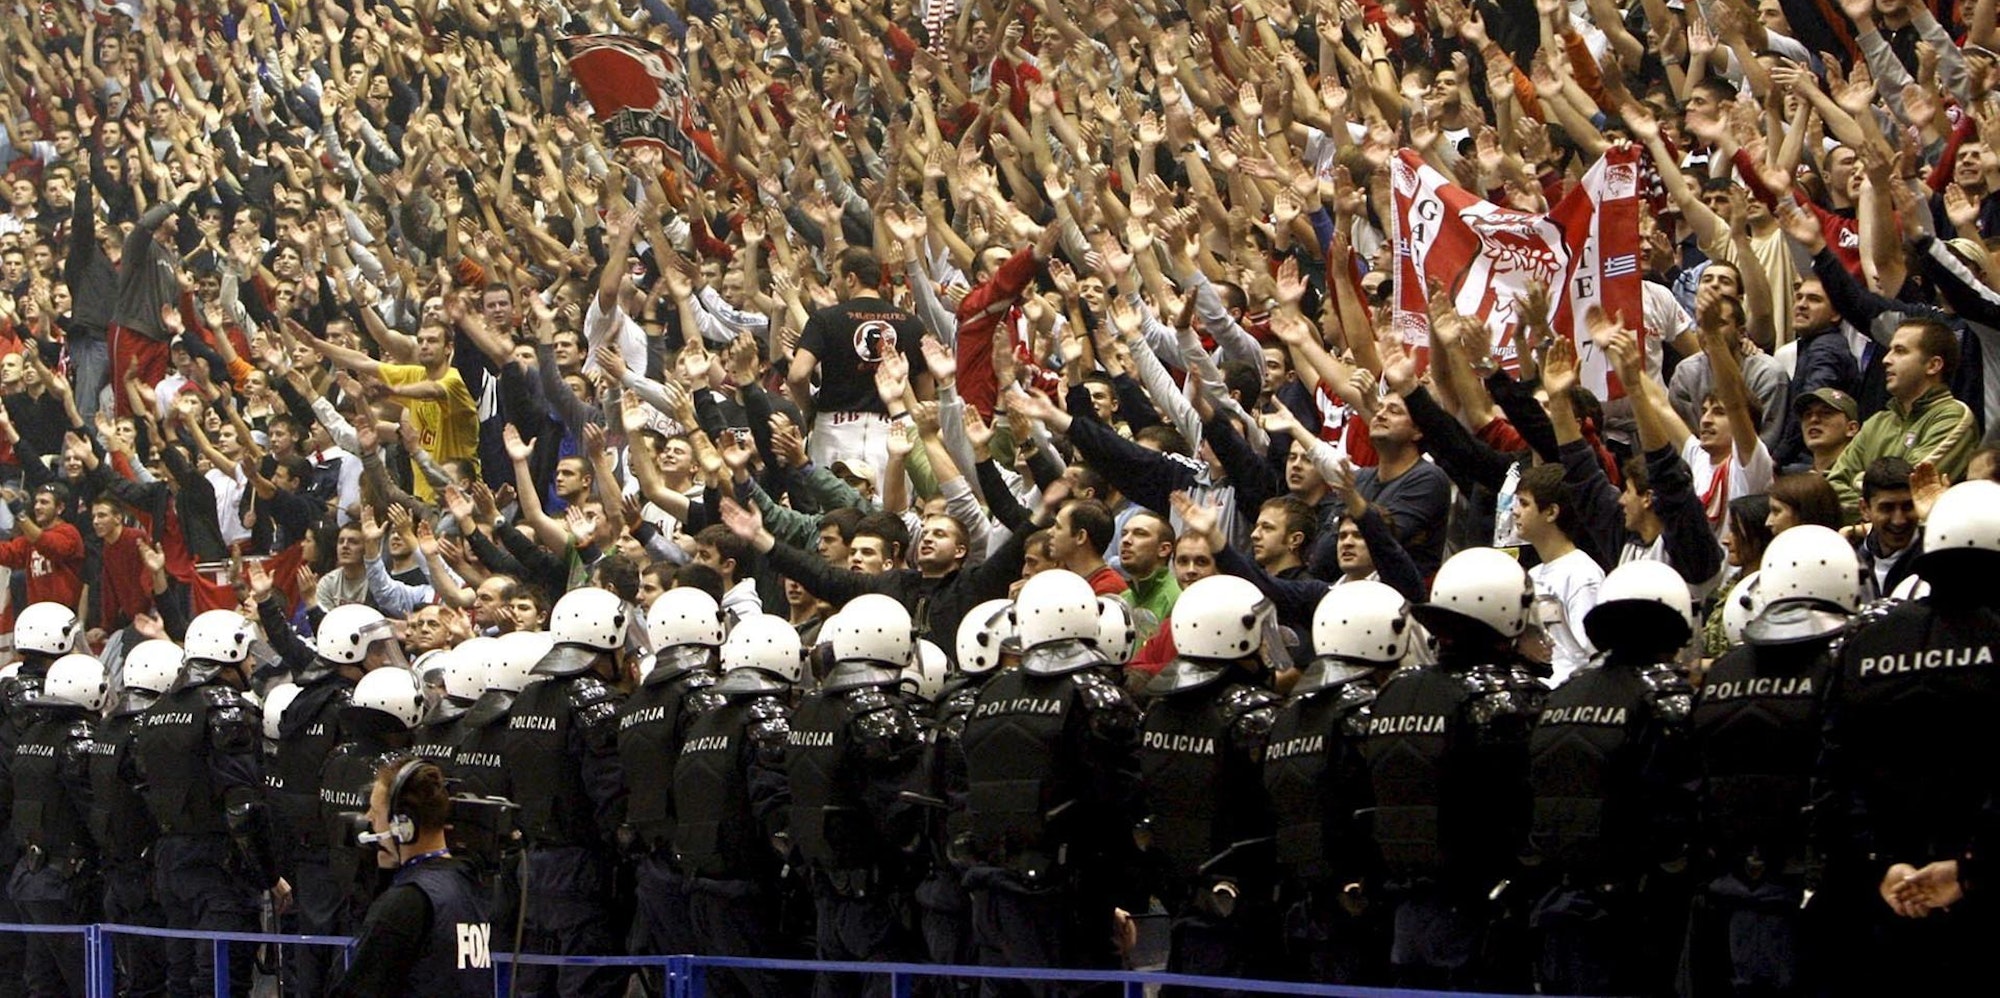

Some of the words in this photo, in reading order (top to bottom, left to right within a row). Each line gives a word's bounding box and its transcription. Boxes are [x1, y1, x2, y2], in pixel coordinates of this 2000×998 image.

[1582, 341, 1593, 362] 7
[1860, 645, 1993, 677] POLICIJA
[1704, 677, 1813, 700] POLICIJA
[148, 711, 193, 726] POLICIJA
[620, 705, 665, 728] POLICIJA
[974, 698, 1062, 718] POLICIJA
[1540, 706, 1628, 726] POLICIJA
[509, 715, 557, 731] POLICIJA
[1369, 714, 1446, 735] POLICIJA
[682, 735, 728, 756] POLICIJA
[787, 730, 834, 747] POLICIJA
[1143, 731, 1215, 755] POLICIJA
[1265, 734, 1324, 760] POLICIJA
[16, 744, 54, 758] POLICIJA
[455, 753, 501, 768] POLICIJA
[320, 788, 363, 806] POLICIJA
[456, 922, 491, 970] FOX
